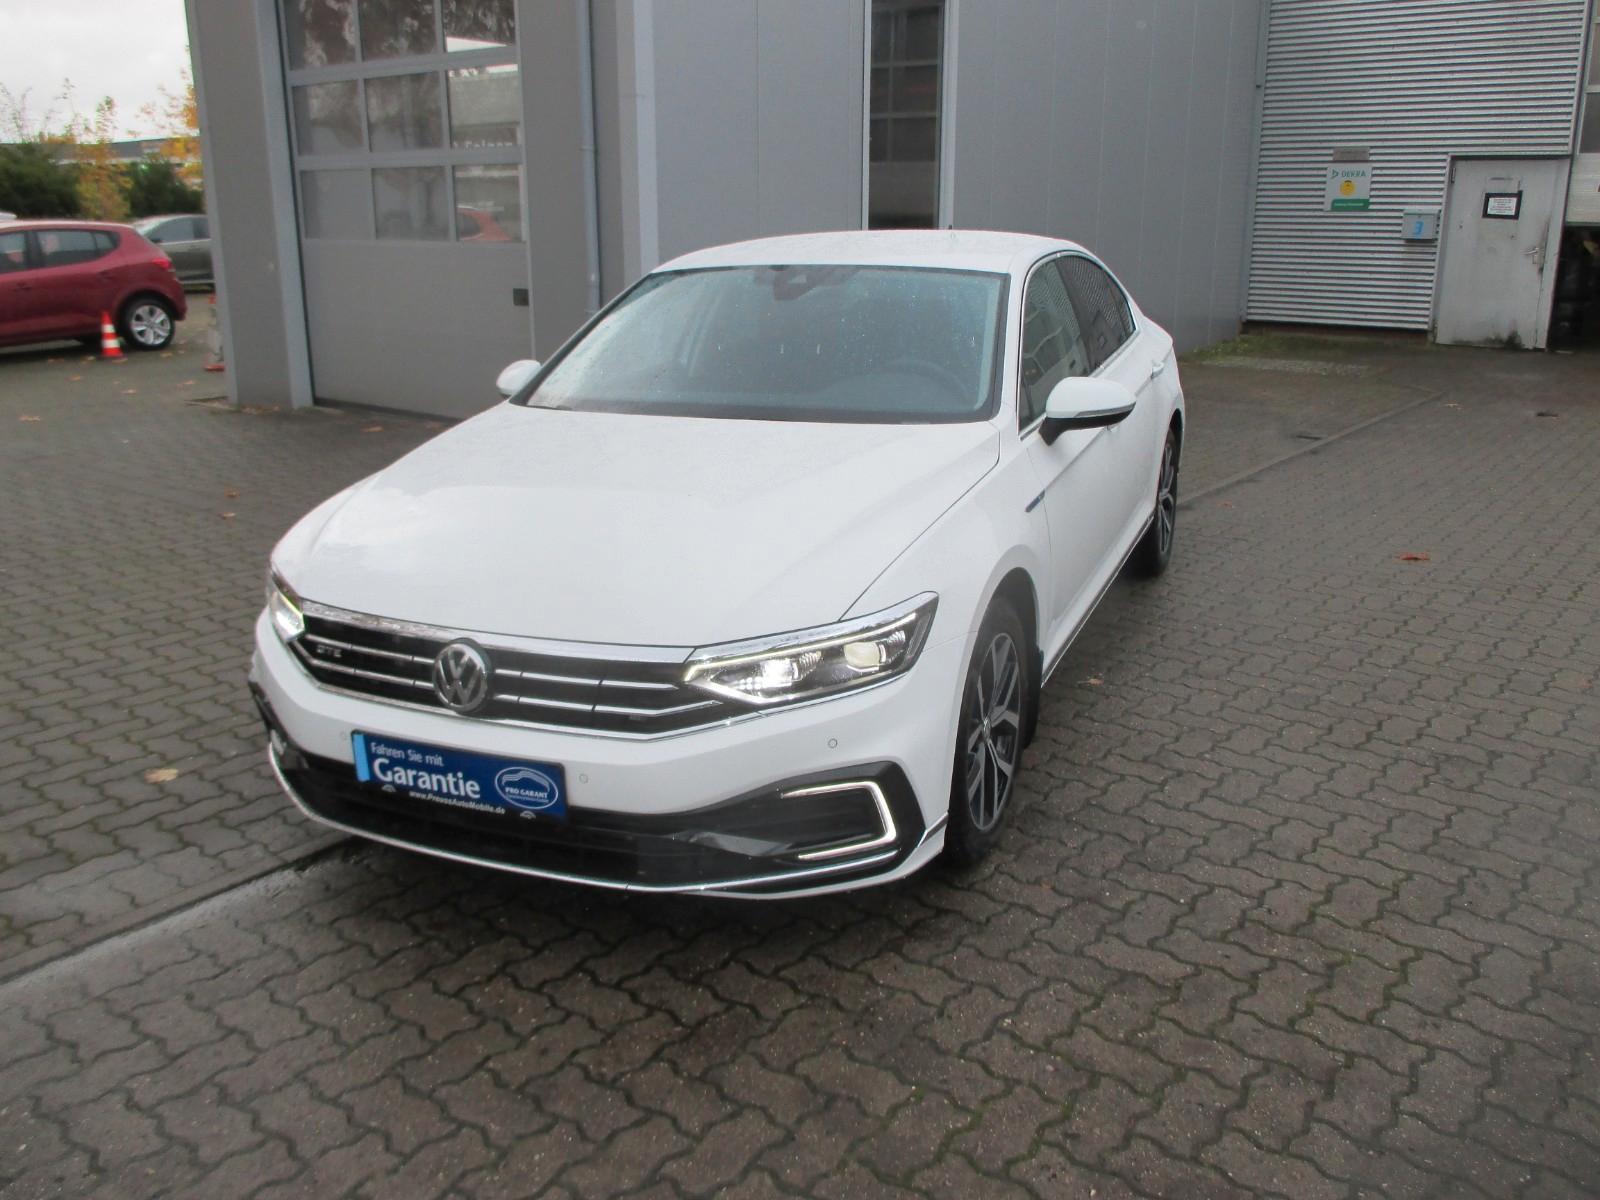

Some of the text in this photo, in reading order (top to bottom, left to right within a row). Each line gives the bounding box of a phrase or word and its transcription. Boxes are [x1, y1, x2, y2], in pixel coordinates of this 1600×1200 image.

[370, 742, 444, 767] Fahren Sie mit
[373, 757, 481, 799] Garantie
[505, 786, 520, 795] PRO
[520, 789, 548, 799] GARANT
